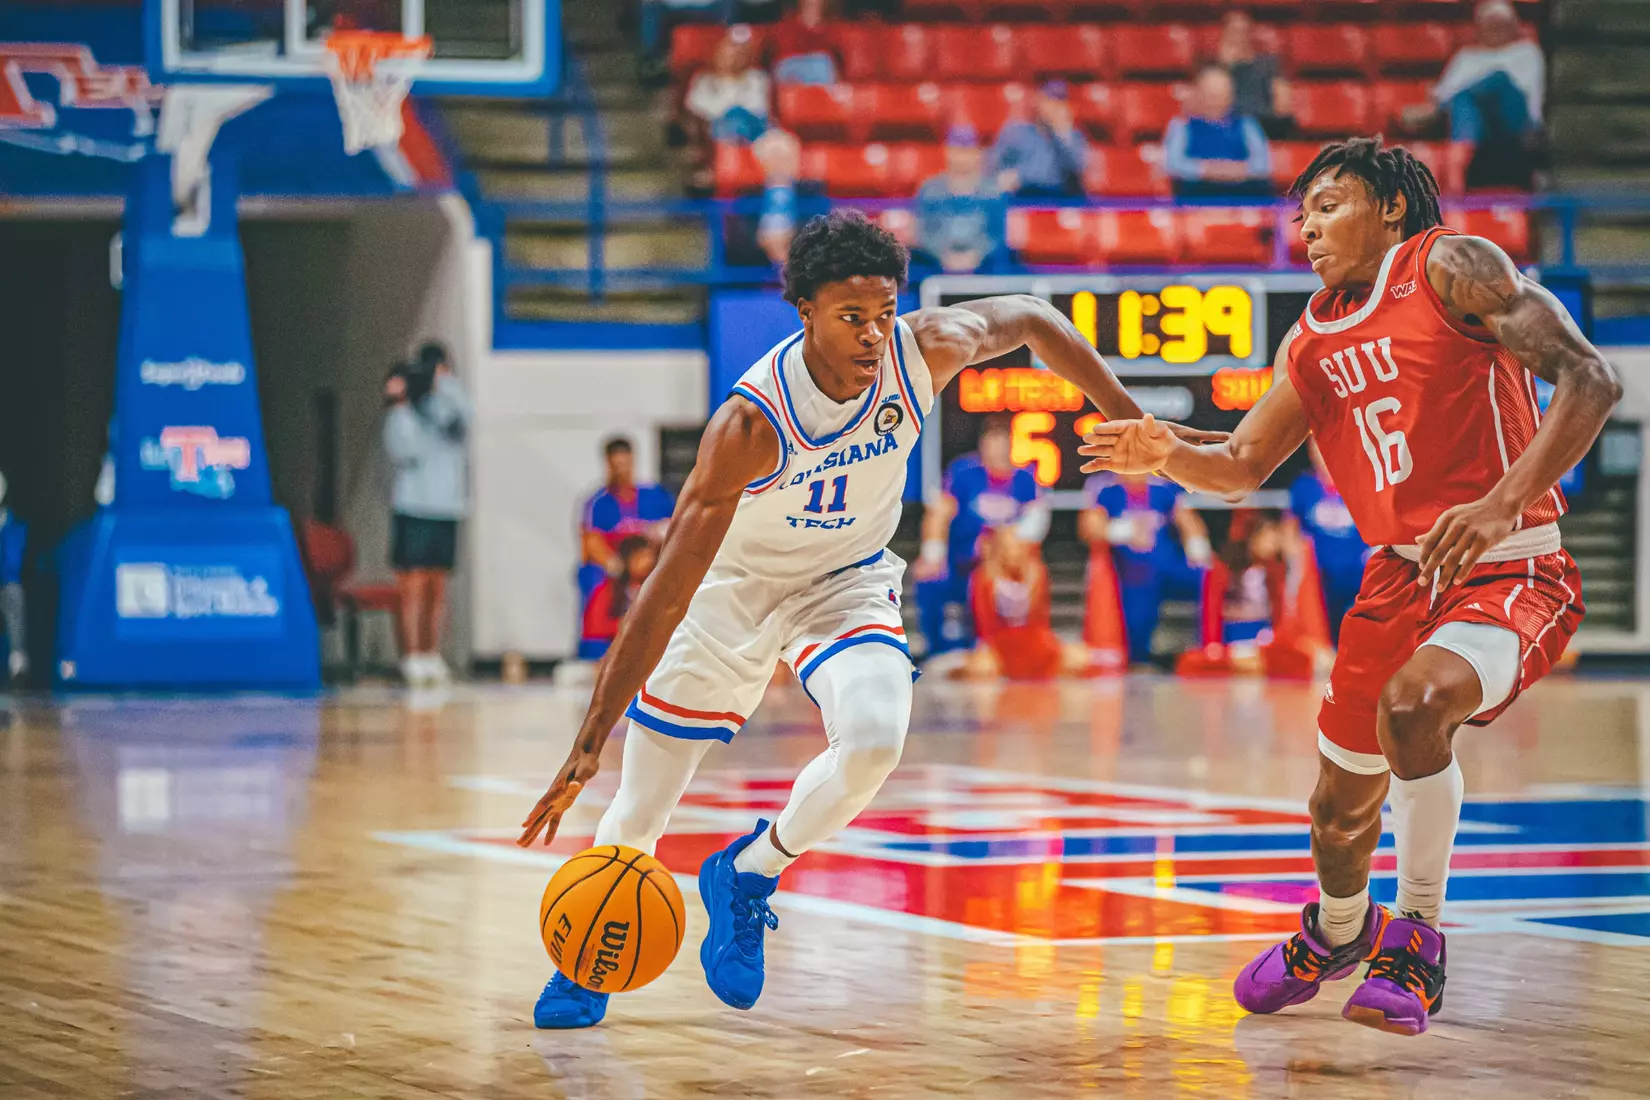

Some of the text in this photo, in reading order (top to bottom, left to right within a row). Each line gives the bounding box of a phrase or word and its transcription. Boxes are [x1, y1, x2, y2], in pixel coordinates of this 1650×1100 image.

[1072, 284, 1252, 363] 11:39
[1319, 336, 1399, 399] SUU
[779, 432, 899, 490] OSIANA
[1352, 396, 1414, 492] 16
[786, 515, 856, 530] TECH
[803, 474, 848, 514] 11
